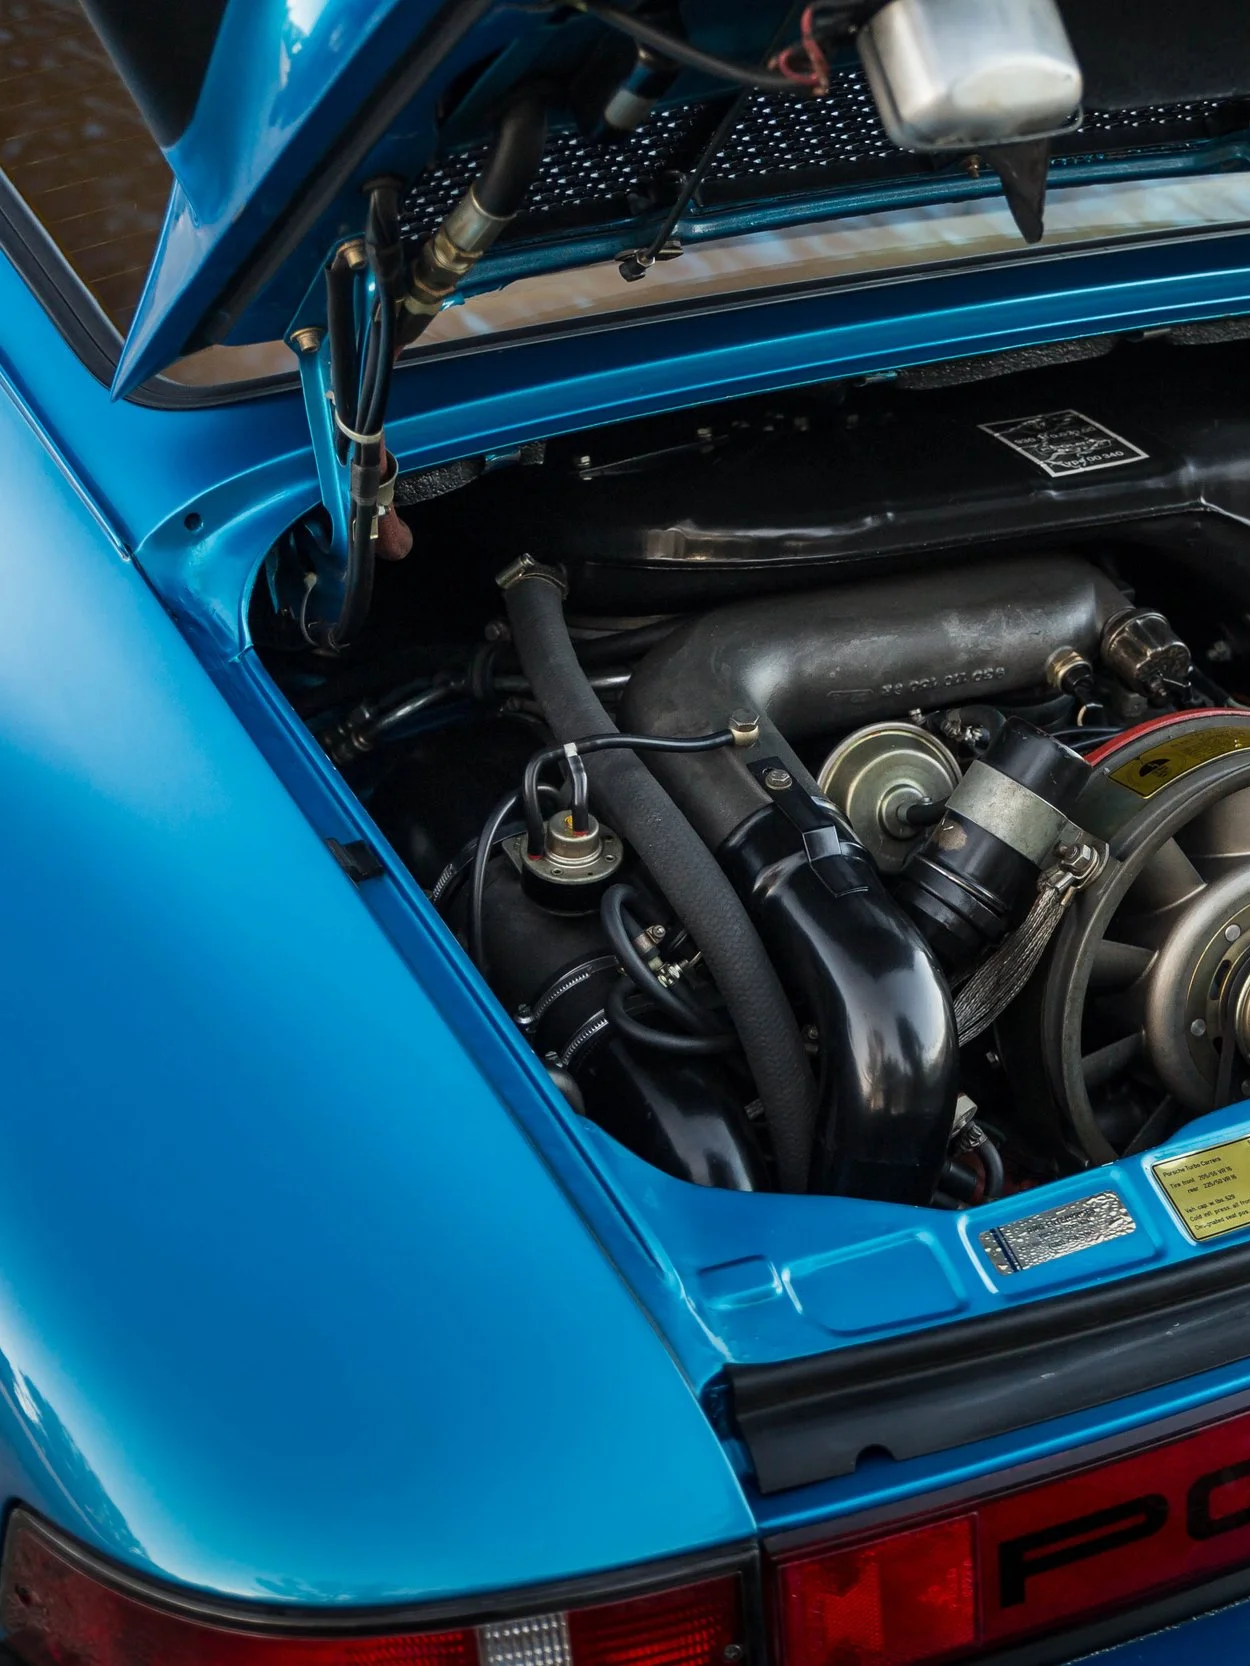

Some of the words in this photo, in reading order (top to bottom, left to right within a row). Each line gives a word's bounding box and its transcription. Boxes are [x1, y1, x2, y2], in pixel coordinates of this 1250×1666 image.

[1163, 1168, 1185, 1178] Porsche
[1185, 1163, 1200, 1171] Turbo
[1200, 1157, 1222, 1167] Carrera
[1181, 1177, 1196, 1185] front
[1187, 1186, 1199, 1194] rear
[1190, 1214, 1203, 1222] Cold
